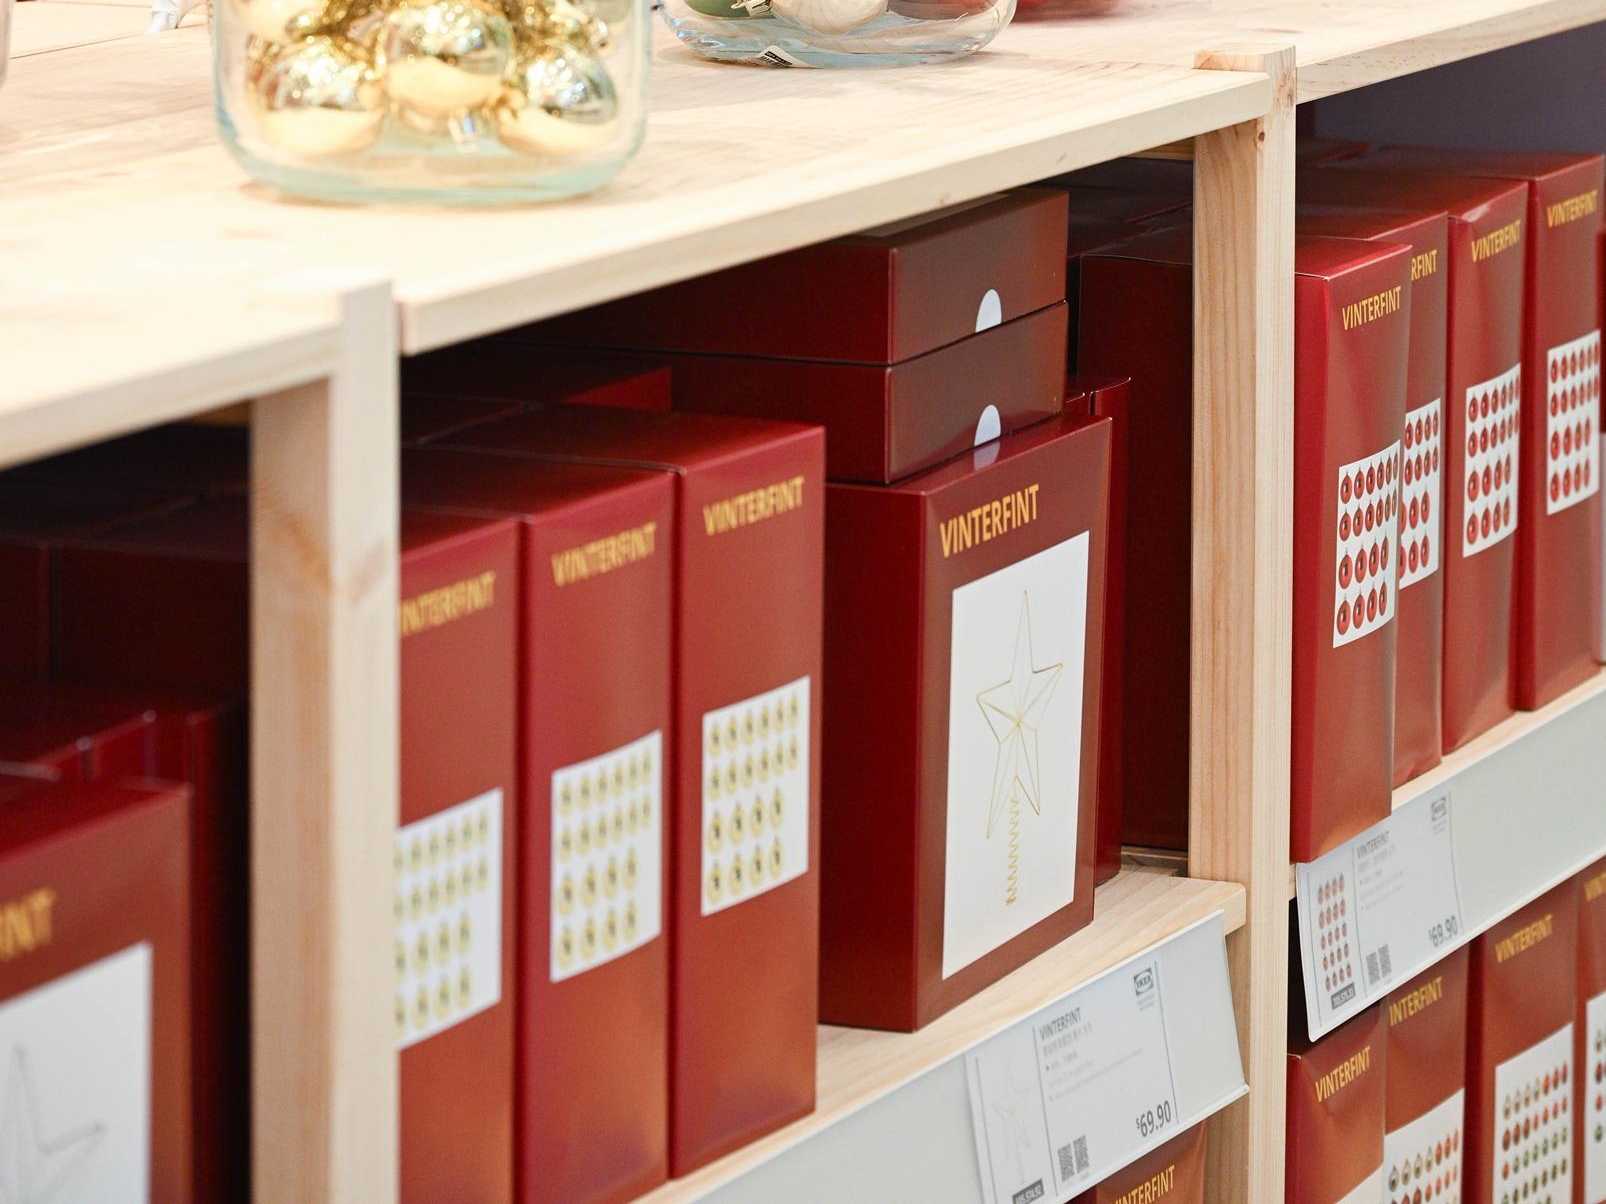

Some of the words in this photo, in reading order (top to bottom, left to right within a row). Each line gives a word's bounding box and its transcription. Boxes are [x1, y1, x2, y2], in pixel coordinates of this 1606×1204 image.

[1547, 190, 1598, 228] VINTERFINT
[1471, 219, 1521, 263] VINTERFINT
[1411, 249, 1438, 282] RFINT
[1342, 285, 1402, 330] VINTERFINT
[702, 476, 804, 536] VINTERFINT
[939, 483, 1039, 558] VINTERFINT
[551, 521, 657, 586] VINTERFINT
[1428, 915, 1458, 948] $69.90
[1389, 976, 1442, 1027] INTERFINT
[1040, 1007, 1081, 1041] VINTERFINT
[1315, 1046, 1370, 1103] VINTERFINT
[1136, 1100, 1171, 1137] $69.90
